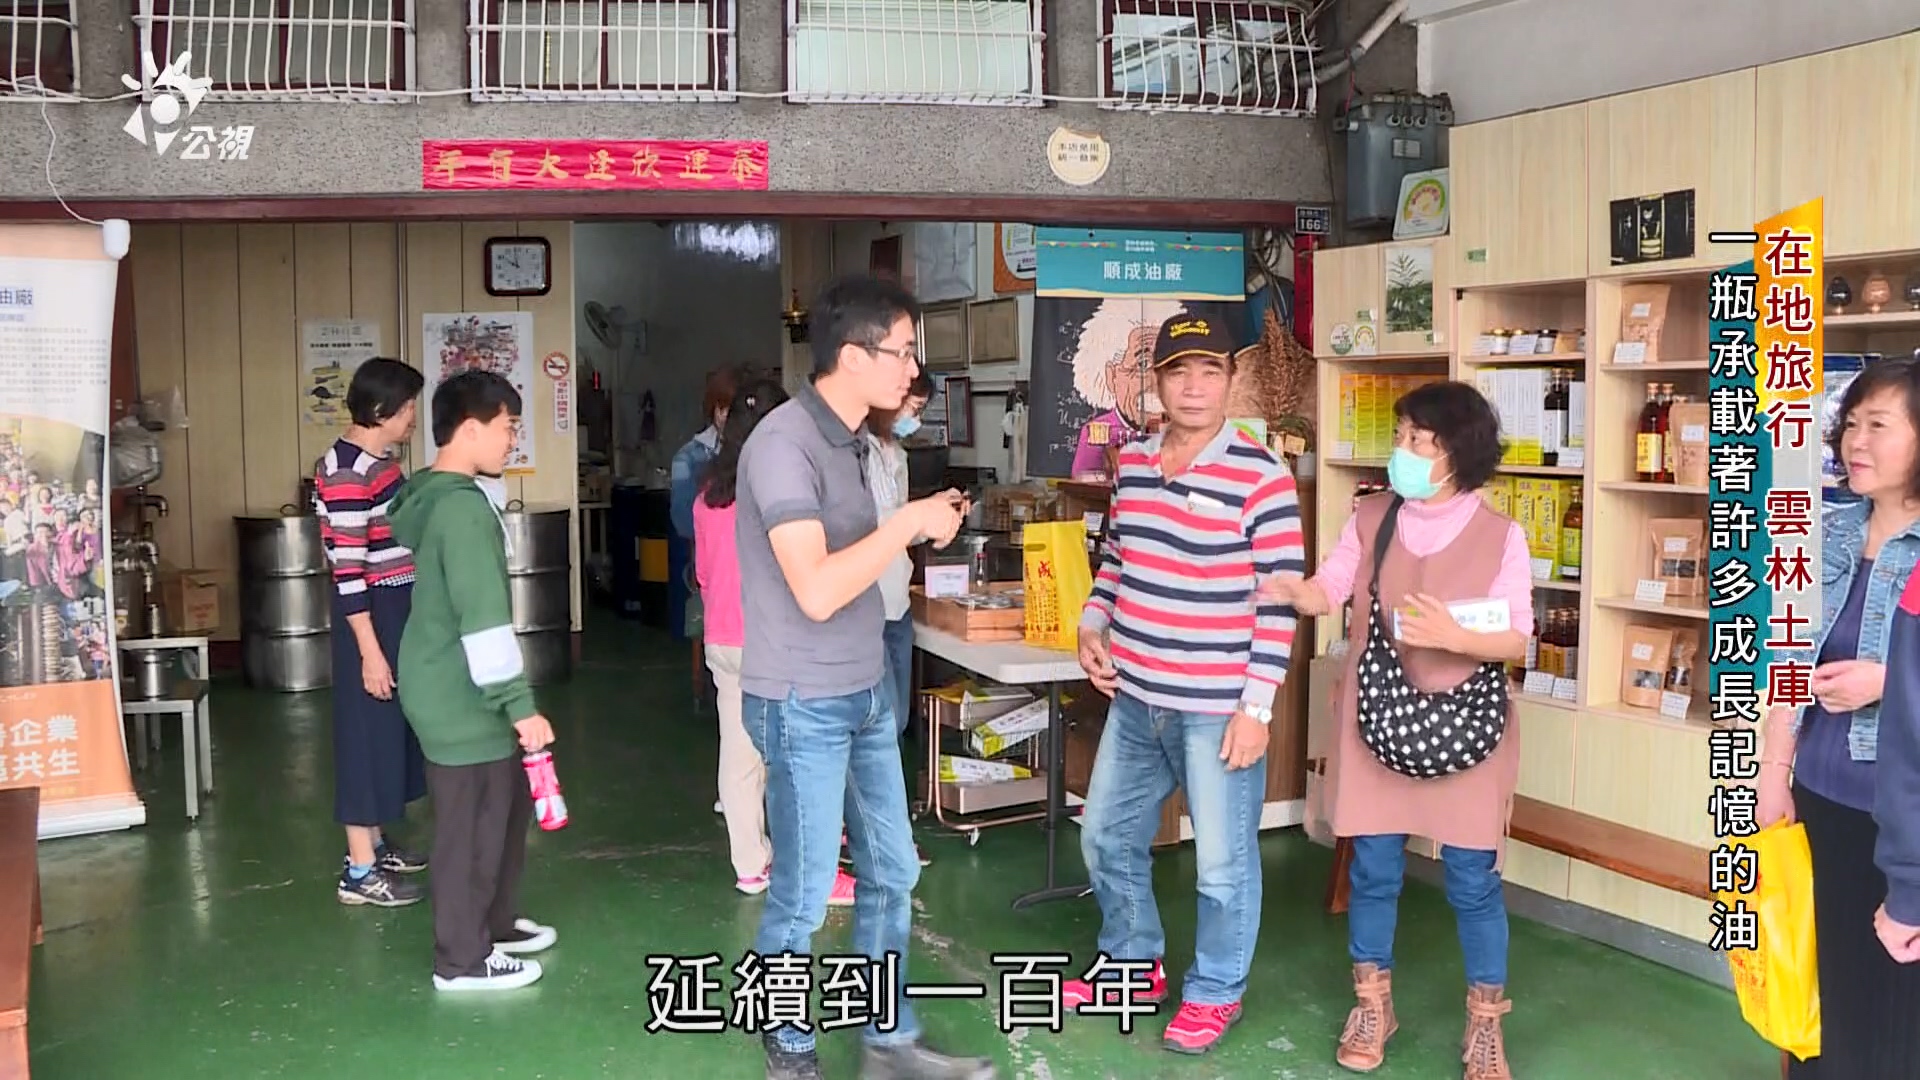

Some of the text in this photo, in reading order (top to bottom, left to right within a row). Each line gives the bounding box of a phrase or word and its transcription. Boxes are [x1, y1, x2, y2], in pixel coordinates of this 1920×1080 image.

[1301, 219, 1321, 230] 166
[1104, 261, 1182, 280] 順成油廠
[0, 714, 78, 748] 企業
[0, 748, 80, 783] 共生
